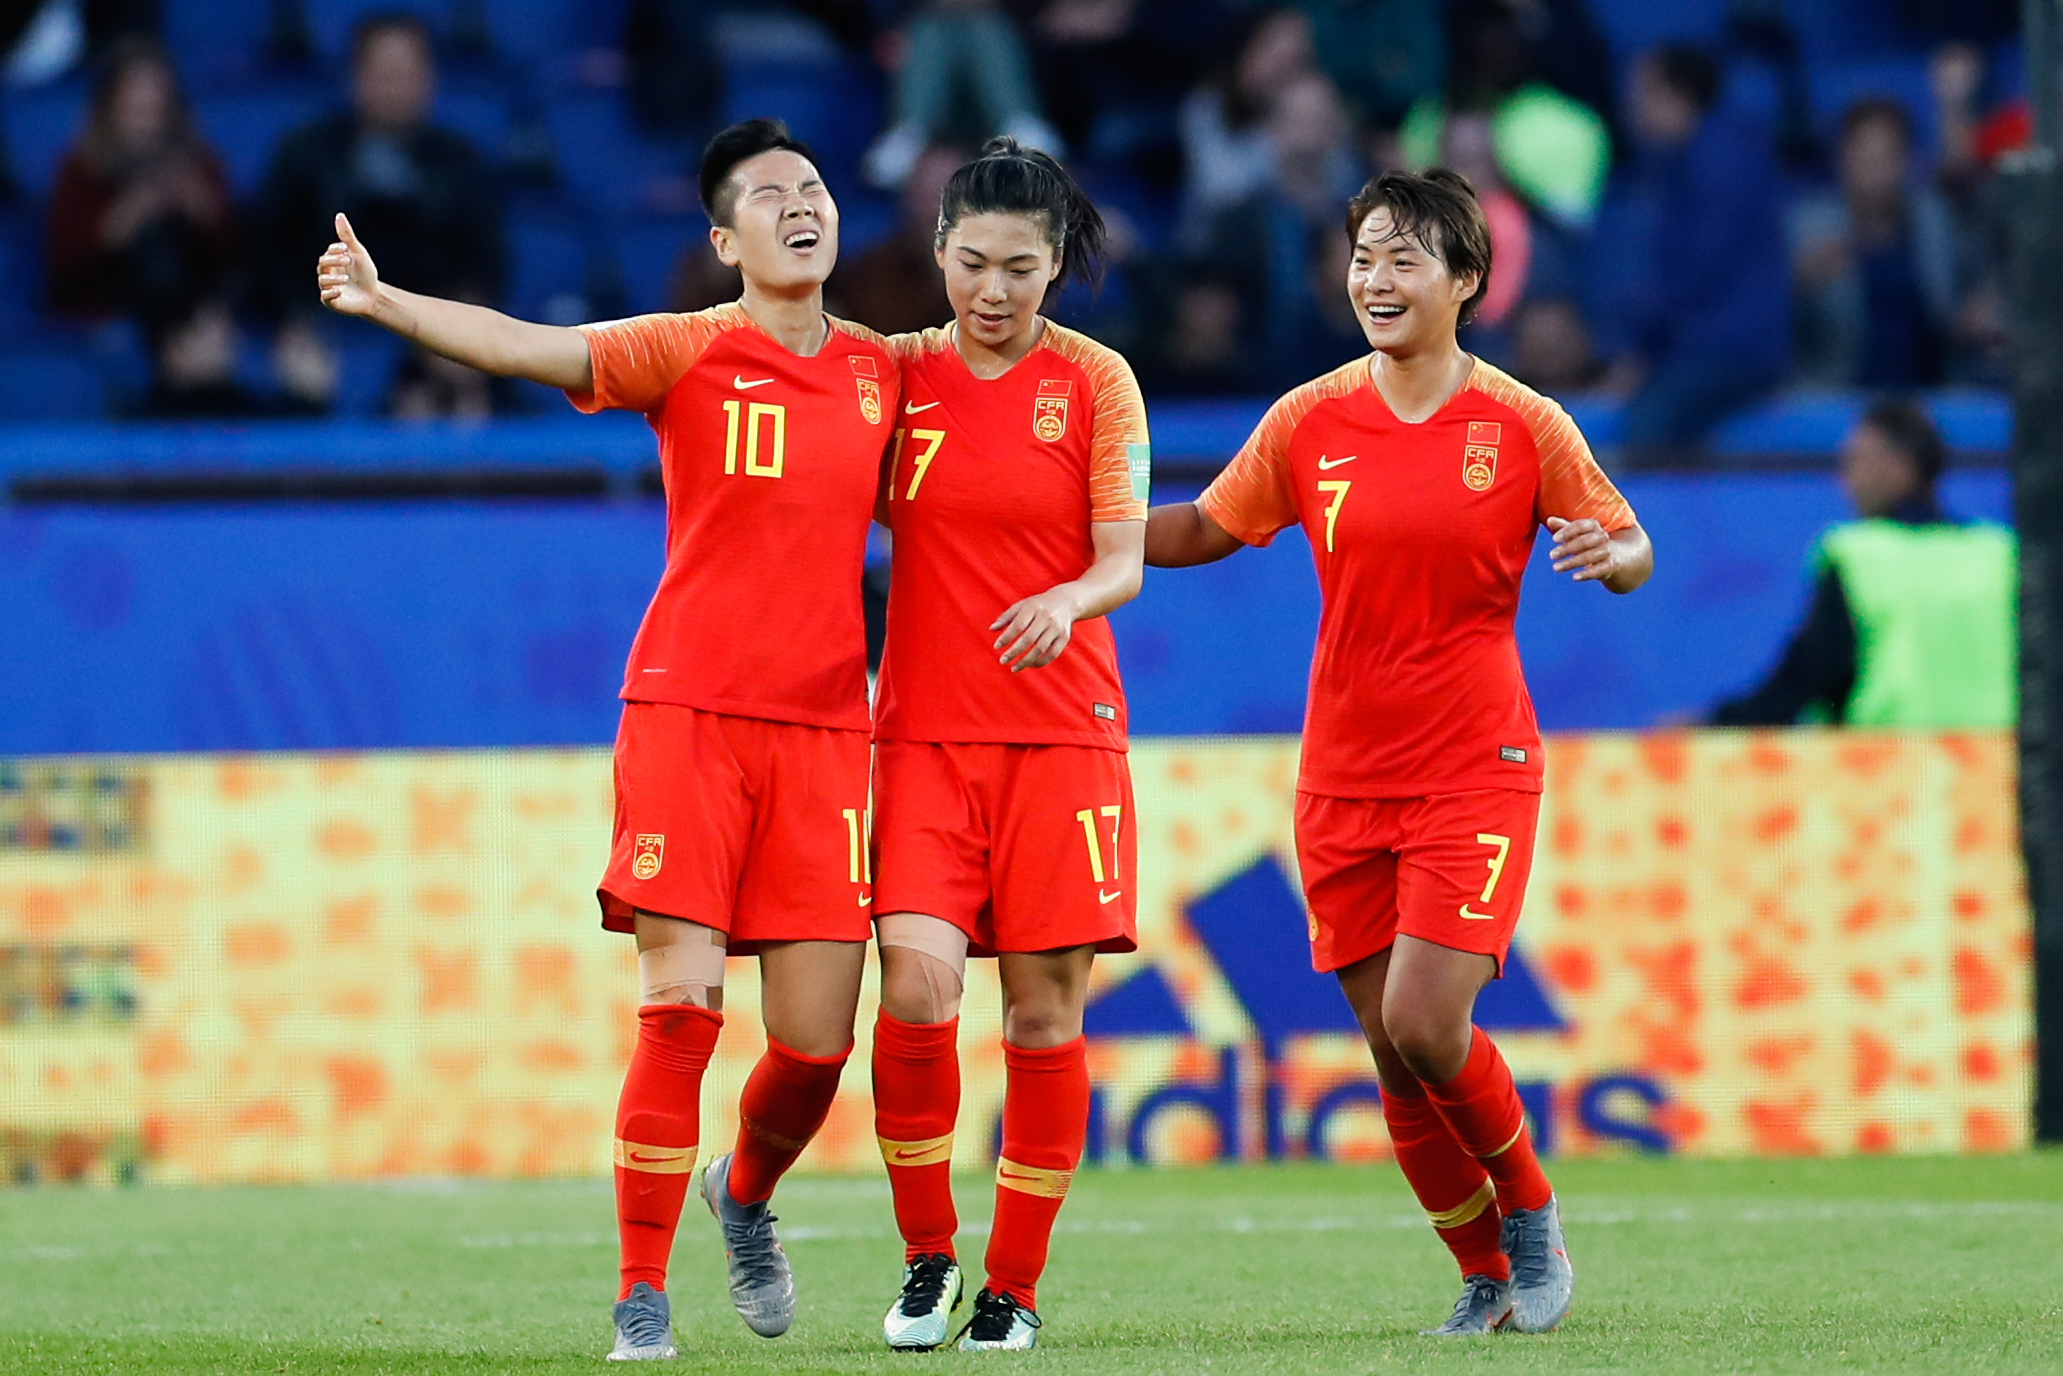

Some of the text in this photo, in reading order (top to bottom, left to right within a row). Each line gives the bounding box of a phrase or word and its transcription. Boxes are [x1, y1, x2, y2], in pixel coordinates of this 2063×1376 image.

[723, 400, 785, 478] 10
[1038, 400, 1064, 410] CFA
[889, 428, 946, 500] 17
[1468, 448, 1494, 459] CFA
[1318, 481, 1351, 552] 7
[638, 837, 662, 847] CFA
[1076, 805, 1121, 882] 17
[1477, 833, 1510, 903] 7
[988, 1040, 1674, 1160] dis
